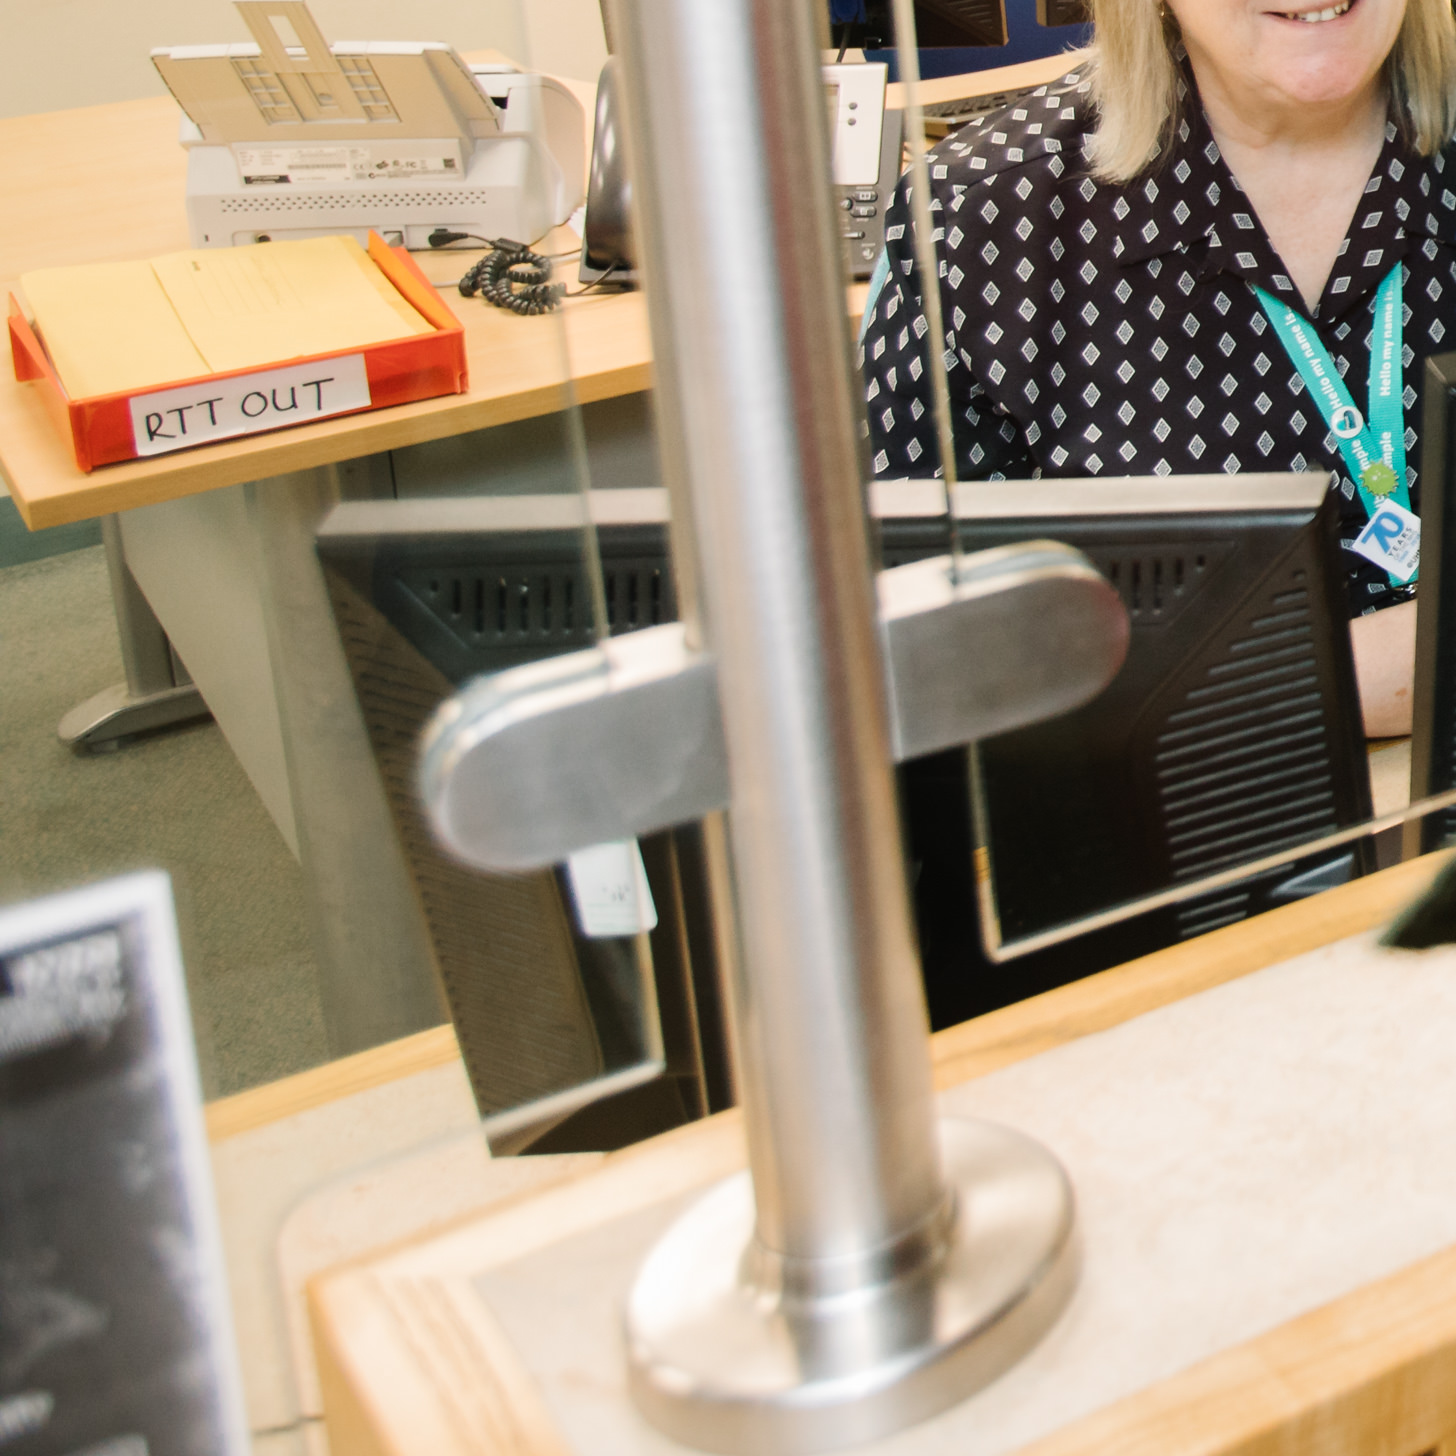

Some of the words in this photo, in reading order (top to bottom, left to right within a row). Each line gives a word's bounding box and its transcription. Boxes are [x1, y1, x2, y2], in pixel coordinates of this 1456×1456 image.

[1383, 306, 1394, 339] name
[1292, 325, 1315, 358] name
[1382, 340, 1395, 361] my
[1309, 358, 1326, 377] my
[1379, 361, 1393, 397] Hello
[145, 397, 224, 442] RTT
[240, 377, 335, 418] OUT
[1320, 377, 1343, 410] Hello
[1361, 511, 1404, 554] 70
[1387, 527, 1413, 557] YEARS
